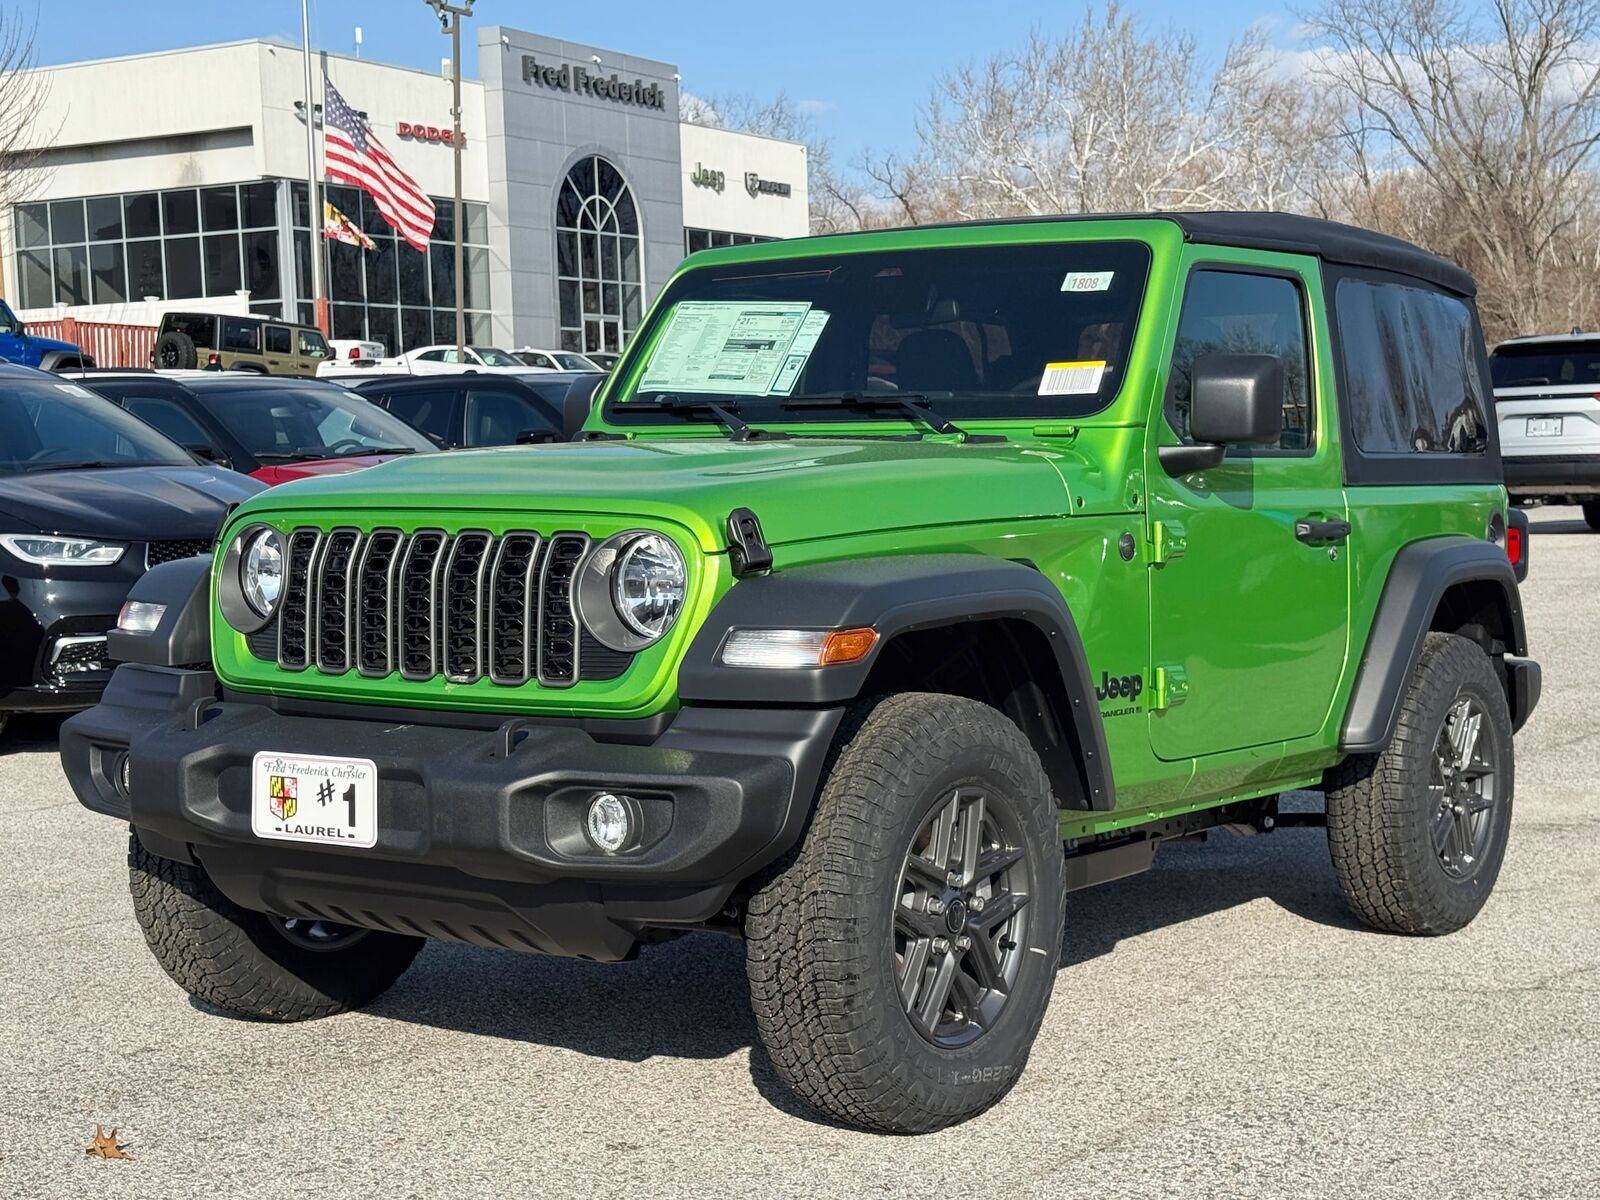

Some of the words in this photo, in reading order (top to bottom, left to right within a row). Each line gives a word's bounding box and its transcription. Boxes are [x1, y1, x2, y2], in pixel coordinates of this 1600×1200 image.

[522, 55, 570, 91] Fred
[573, 66, 664, 110] Frederick
[690, 162, 725, 194] Jeep
[1071, 277, 1099, 290] 1808
[1095, 671, 1143, 702] Jeep
[1100, 706, 1135, 718] RANGLER
[263, 760, 286, 773] Fred
[288, 763, 329, 777] Frederick
[332, 766, 367, 780] Chrysler
[285, 823, 345, 838] LAUREL
